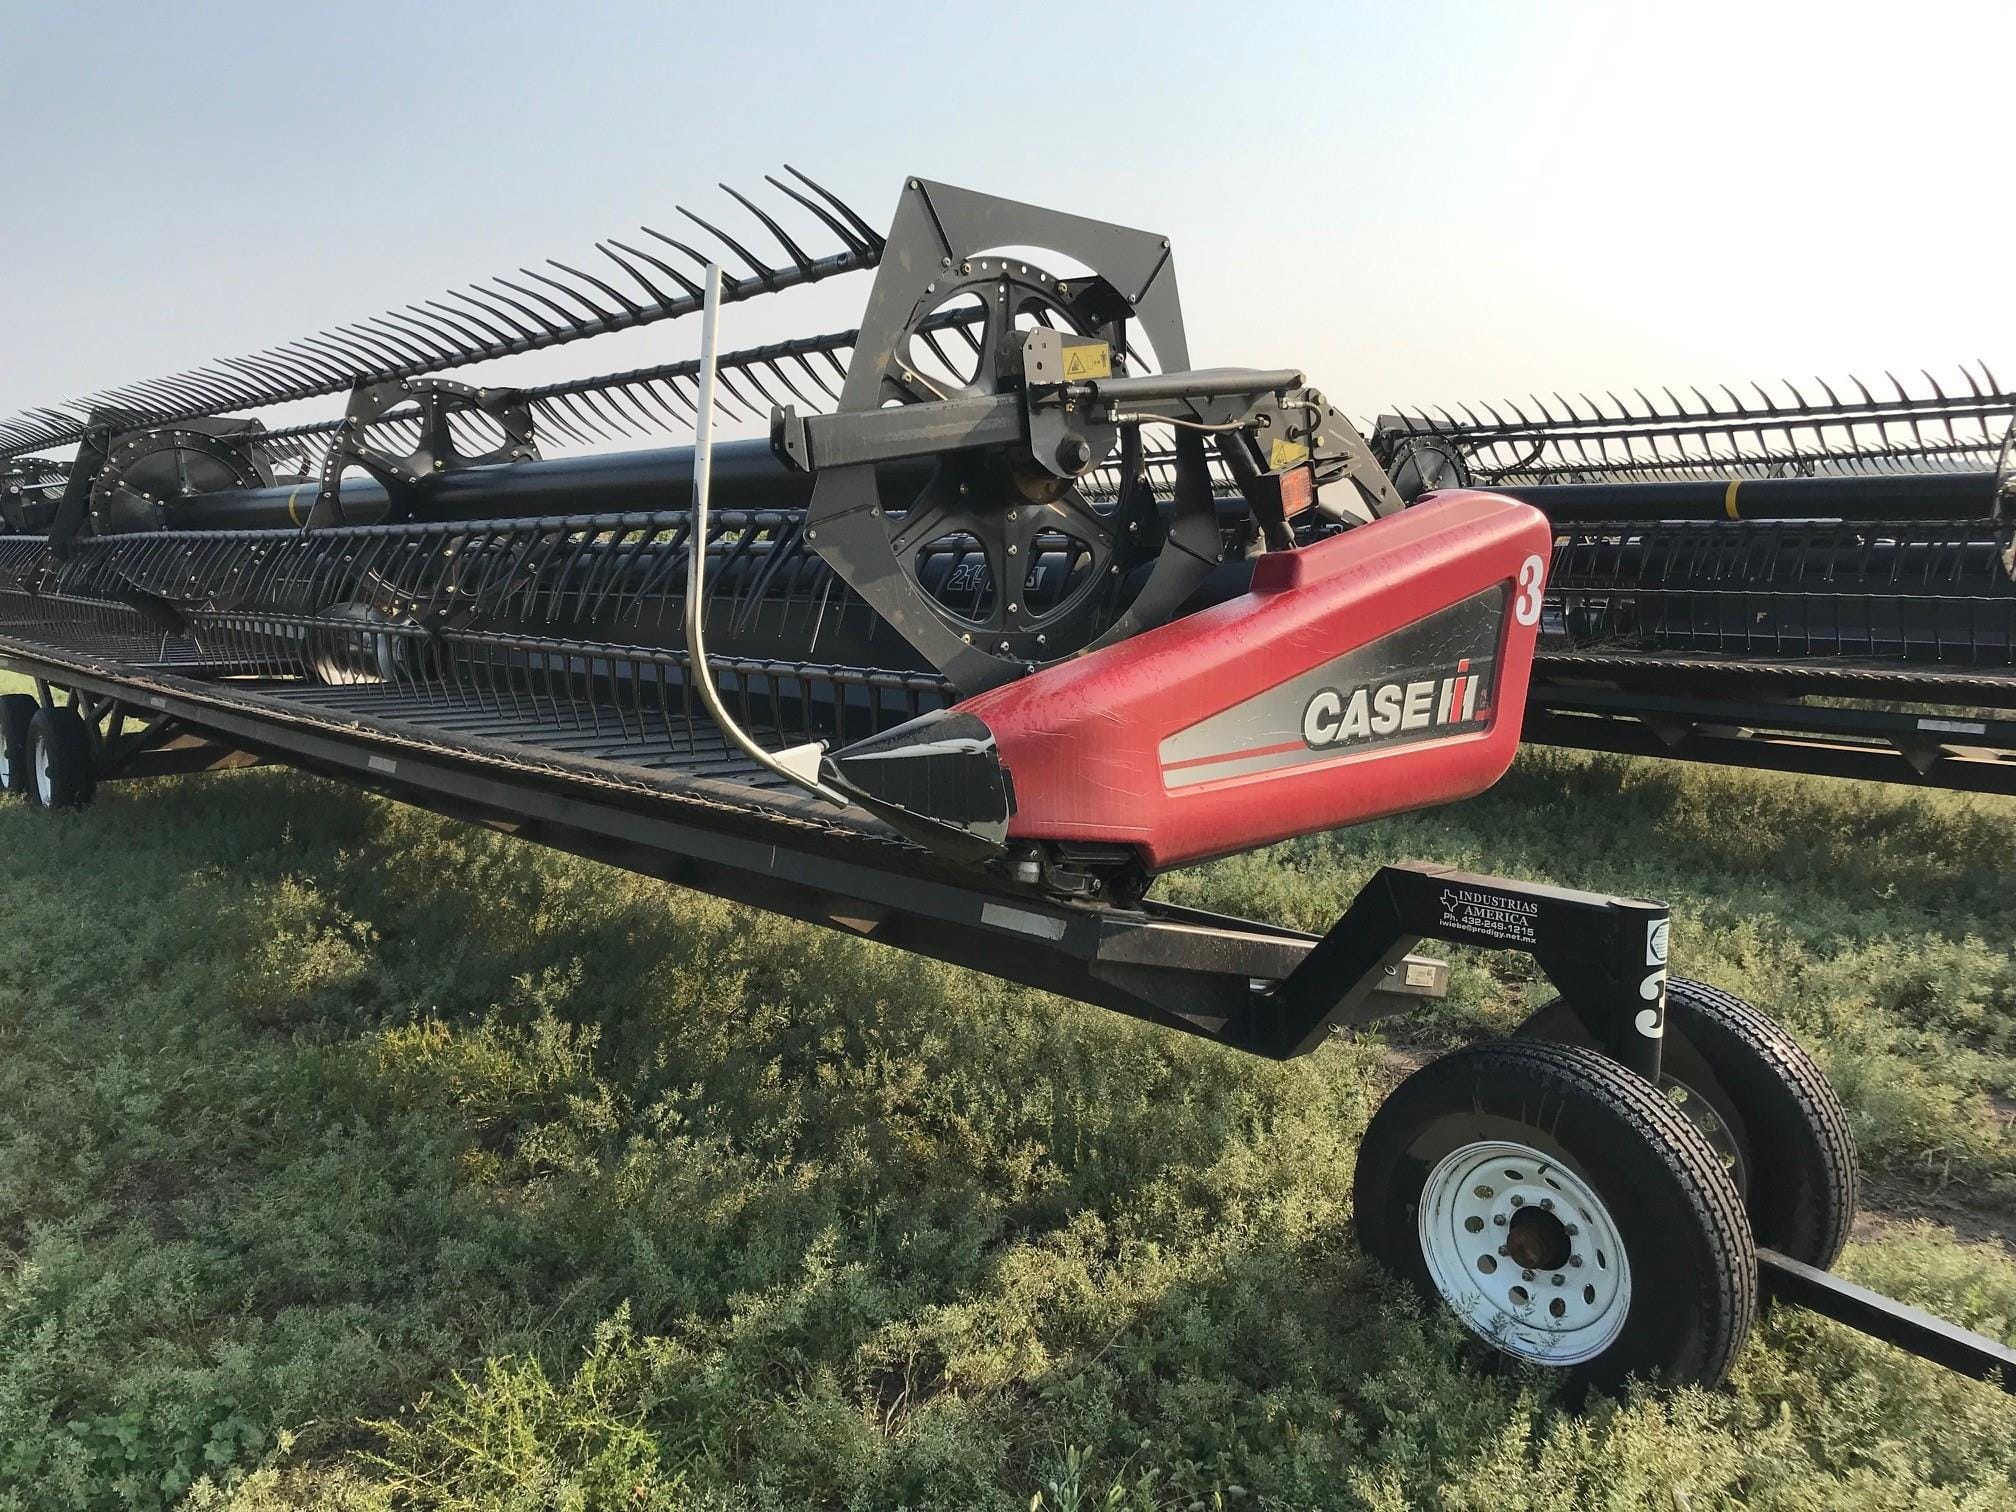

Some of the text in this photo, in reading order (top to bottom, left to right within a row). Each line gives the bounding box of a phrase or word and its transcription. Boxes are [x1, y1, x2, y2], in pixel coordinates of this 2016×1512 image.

[1515, 554, 1544, 626] 3
[1304, 680, 1436, 746] CASE
[1459, 890, 1538, 914] INDUSTRIAS
[1443, 912, 1459, 922] Ph.
[1464, 905, 1529, 927] AMERICA
